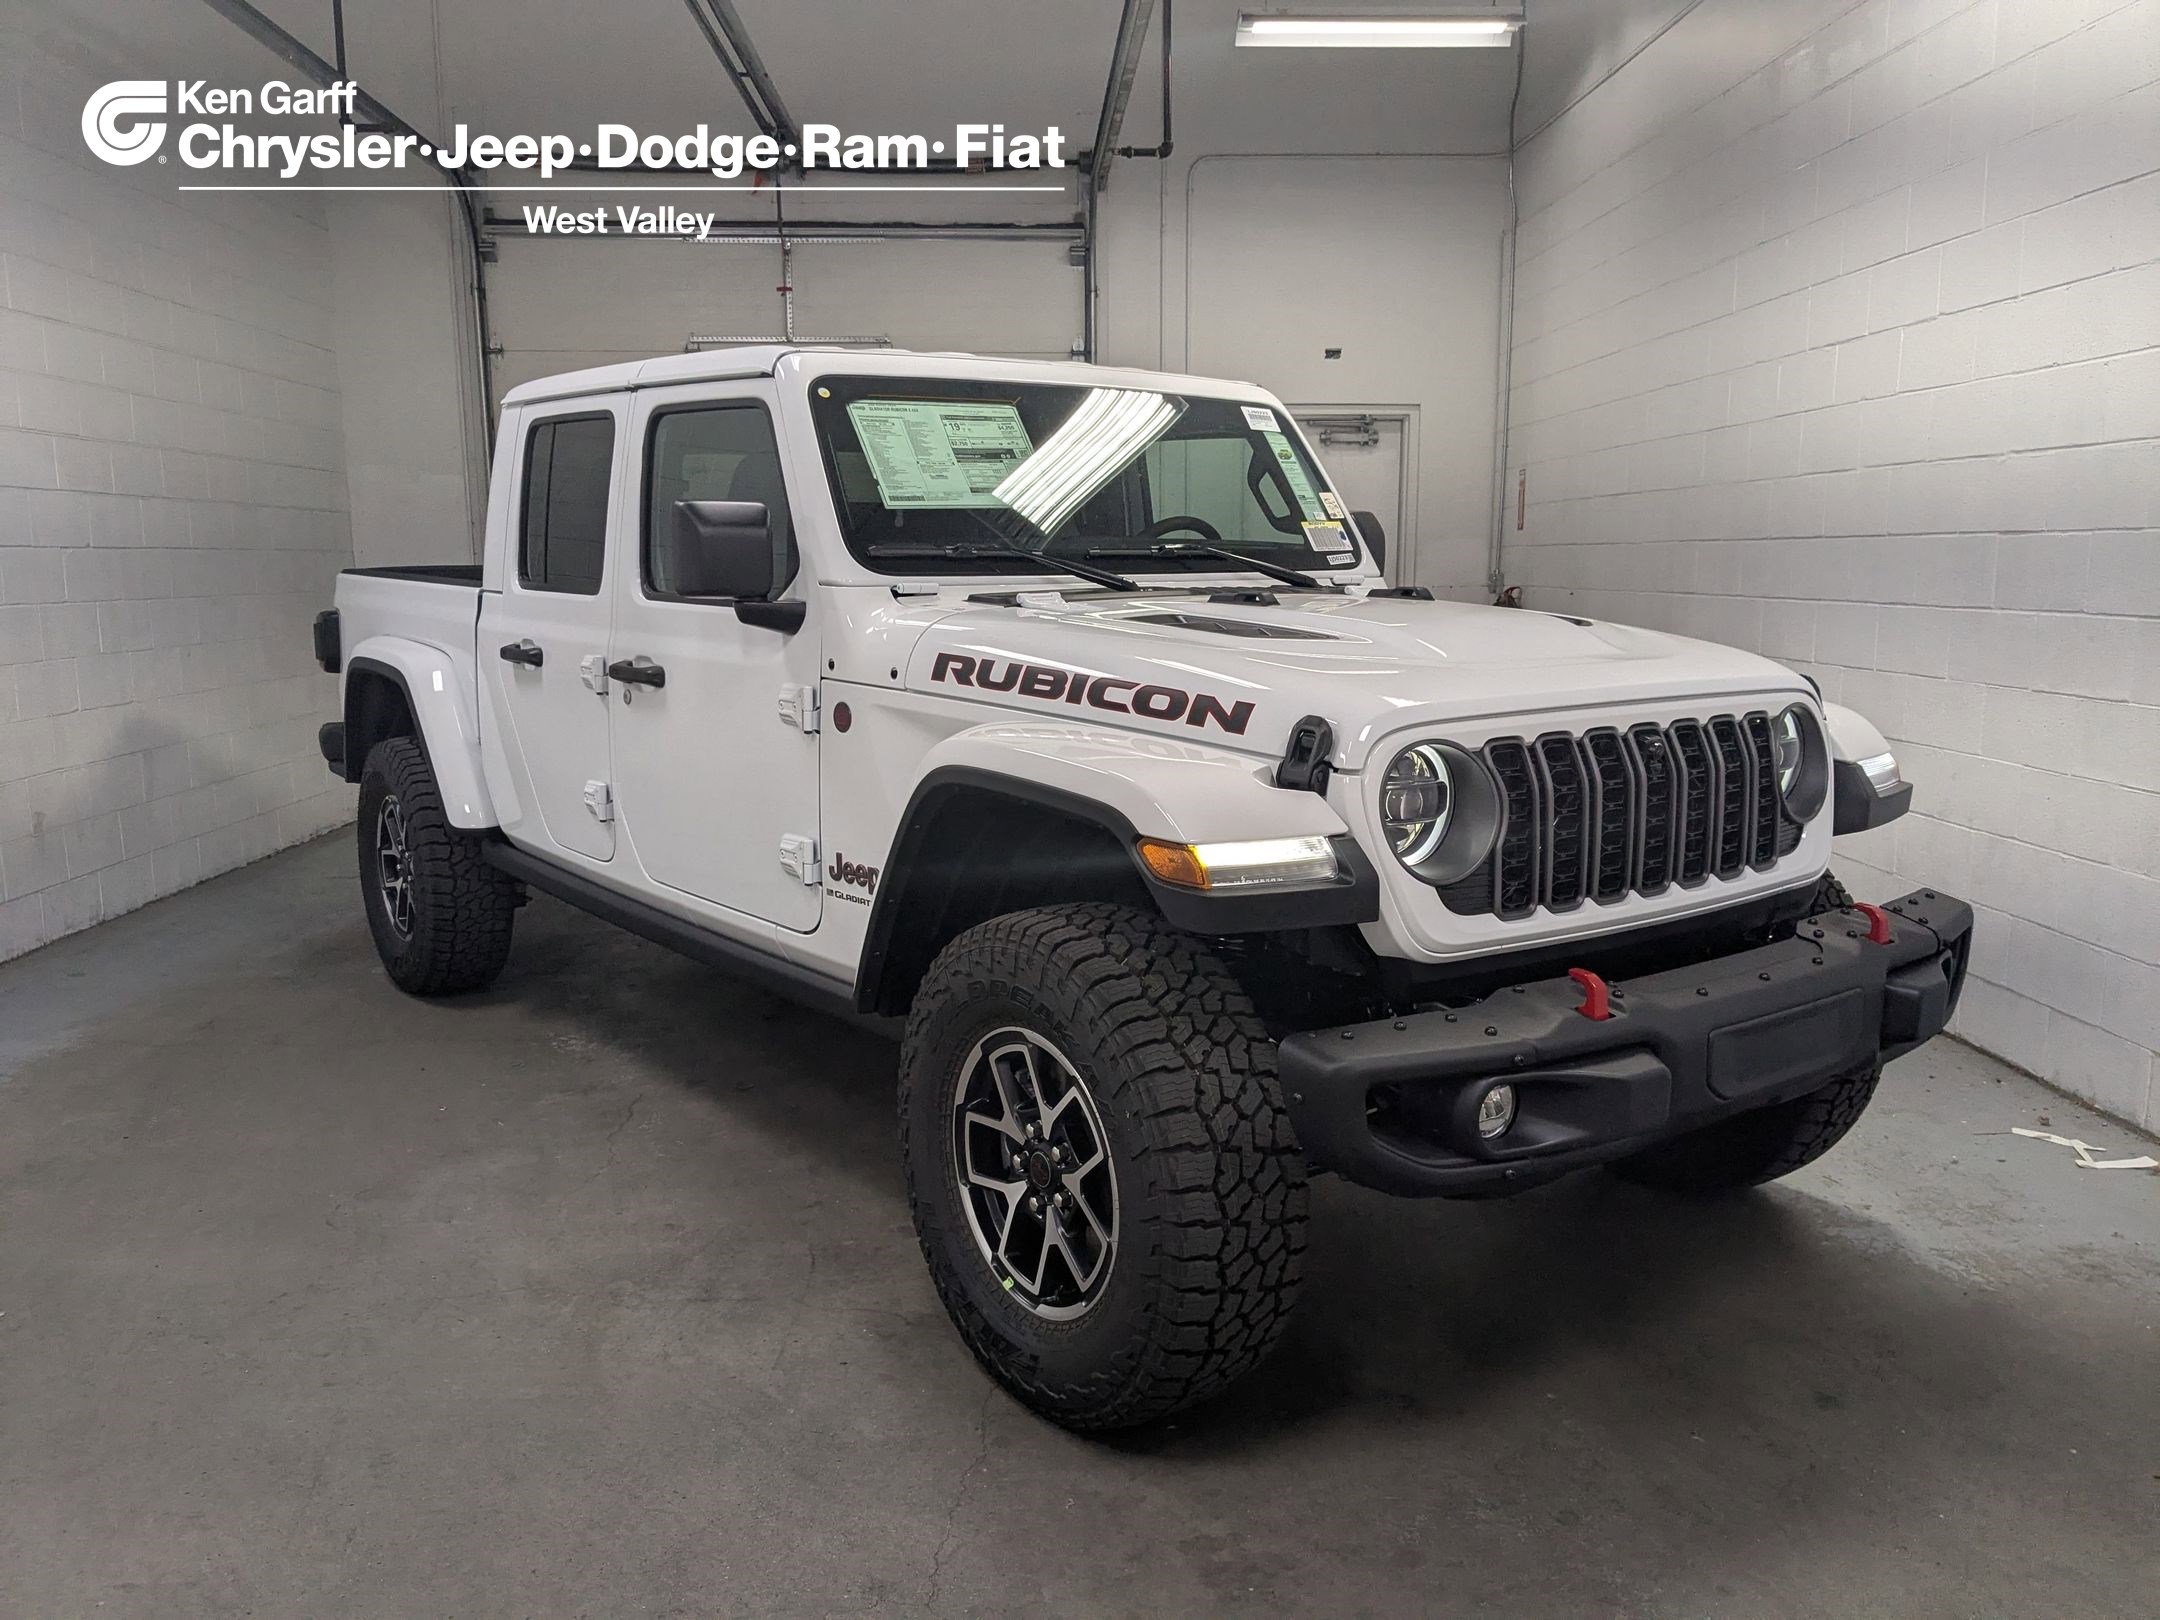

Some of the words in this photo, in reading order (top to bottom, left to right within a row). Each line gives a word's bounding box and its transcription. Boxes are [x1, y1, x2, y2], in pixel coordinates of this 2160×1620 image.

[948, 422, 961, 431] 19
[930, 652, 1257, 736] RUBICON
[828, 851, 880, 896] Jeep
[834, 890, 872, 907] GLADIAT
